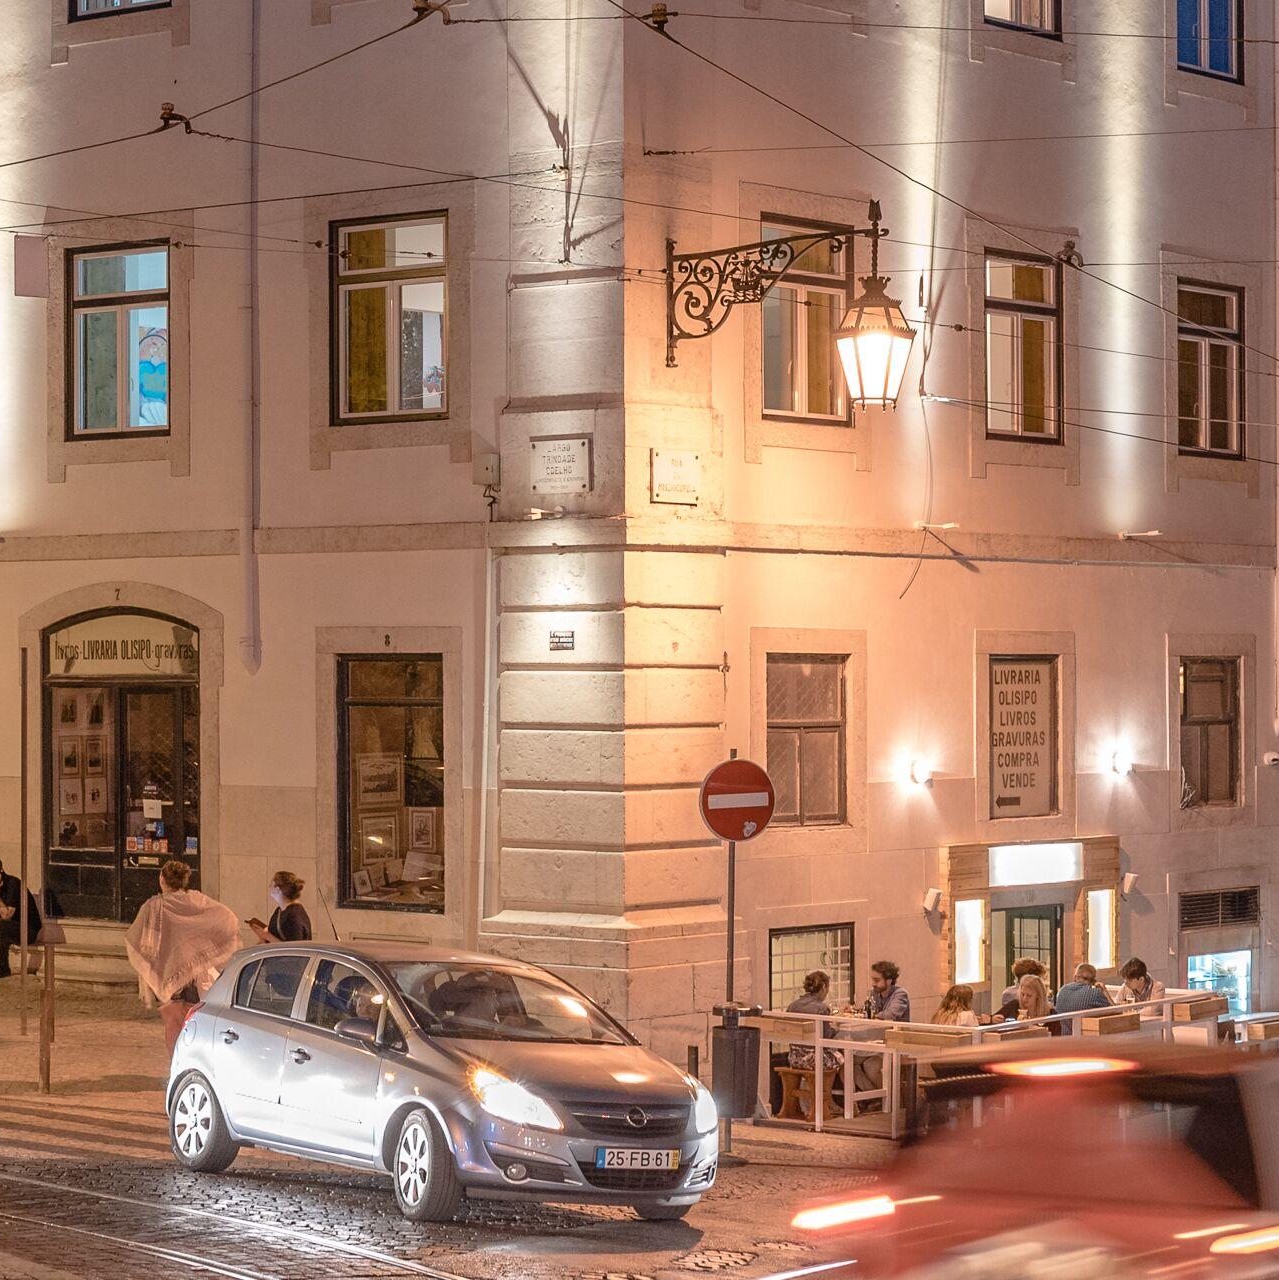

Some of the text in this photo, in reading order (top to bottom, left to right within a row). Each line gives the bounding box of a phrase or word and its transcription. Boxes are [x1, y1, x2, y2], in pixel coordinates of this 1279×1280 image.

[542, 454, 576, 464] TRINDADE
[545, 465, 573, 476] COELHO
[114, 588, 121, 601] 7
[384, 634, 391, 647] 8
[83, 639, 118, 660] LIVRARIA
[121, 639, 151, 660] OLISIPO
[994, 669, 1041, 685] LIVRARIA
[998, 690, 1038, 706] OLISIPO
[1000, 711, 1037, 727] LIVROS
[991, 731, 1046, 747] GRAVURAS
[997, 752, 1040, 768] COMPRA
[1002, 772, 1036, 789] VENDE
